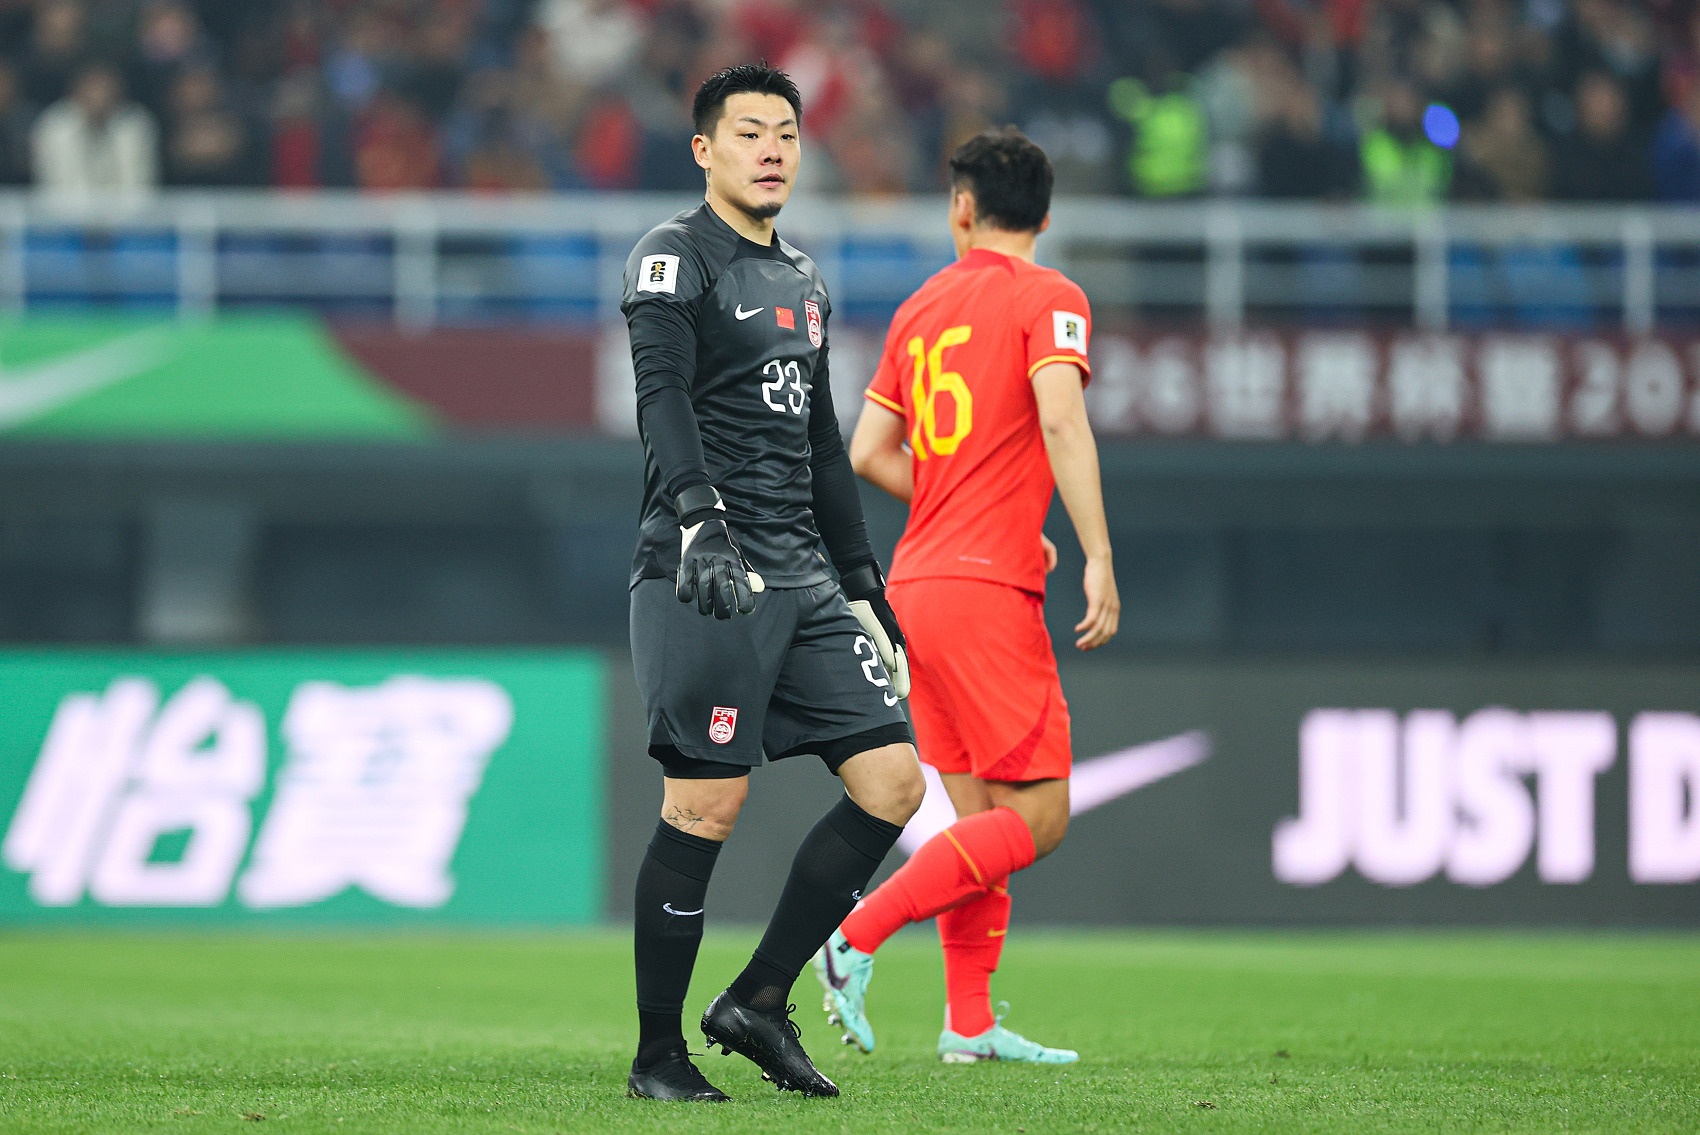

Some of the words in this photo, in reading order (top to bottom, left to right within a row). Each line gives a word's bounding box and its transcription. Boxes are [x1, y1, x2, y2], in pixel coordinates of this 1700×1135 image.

[761, 358, 806, 415] 23
[906, 324, 974, 461] 16
[1272, 707, 1617, 886] JUST
